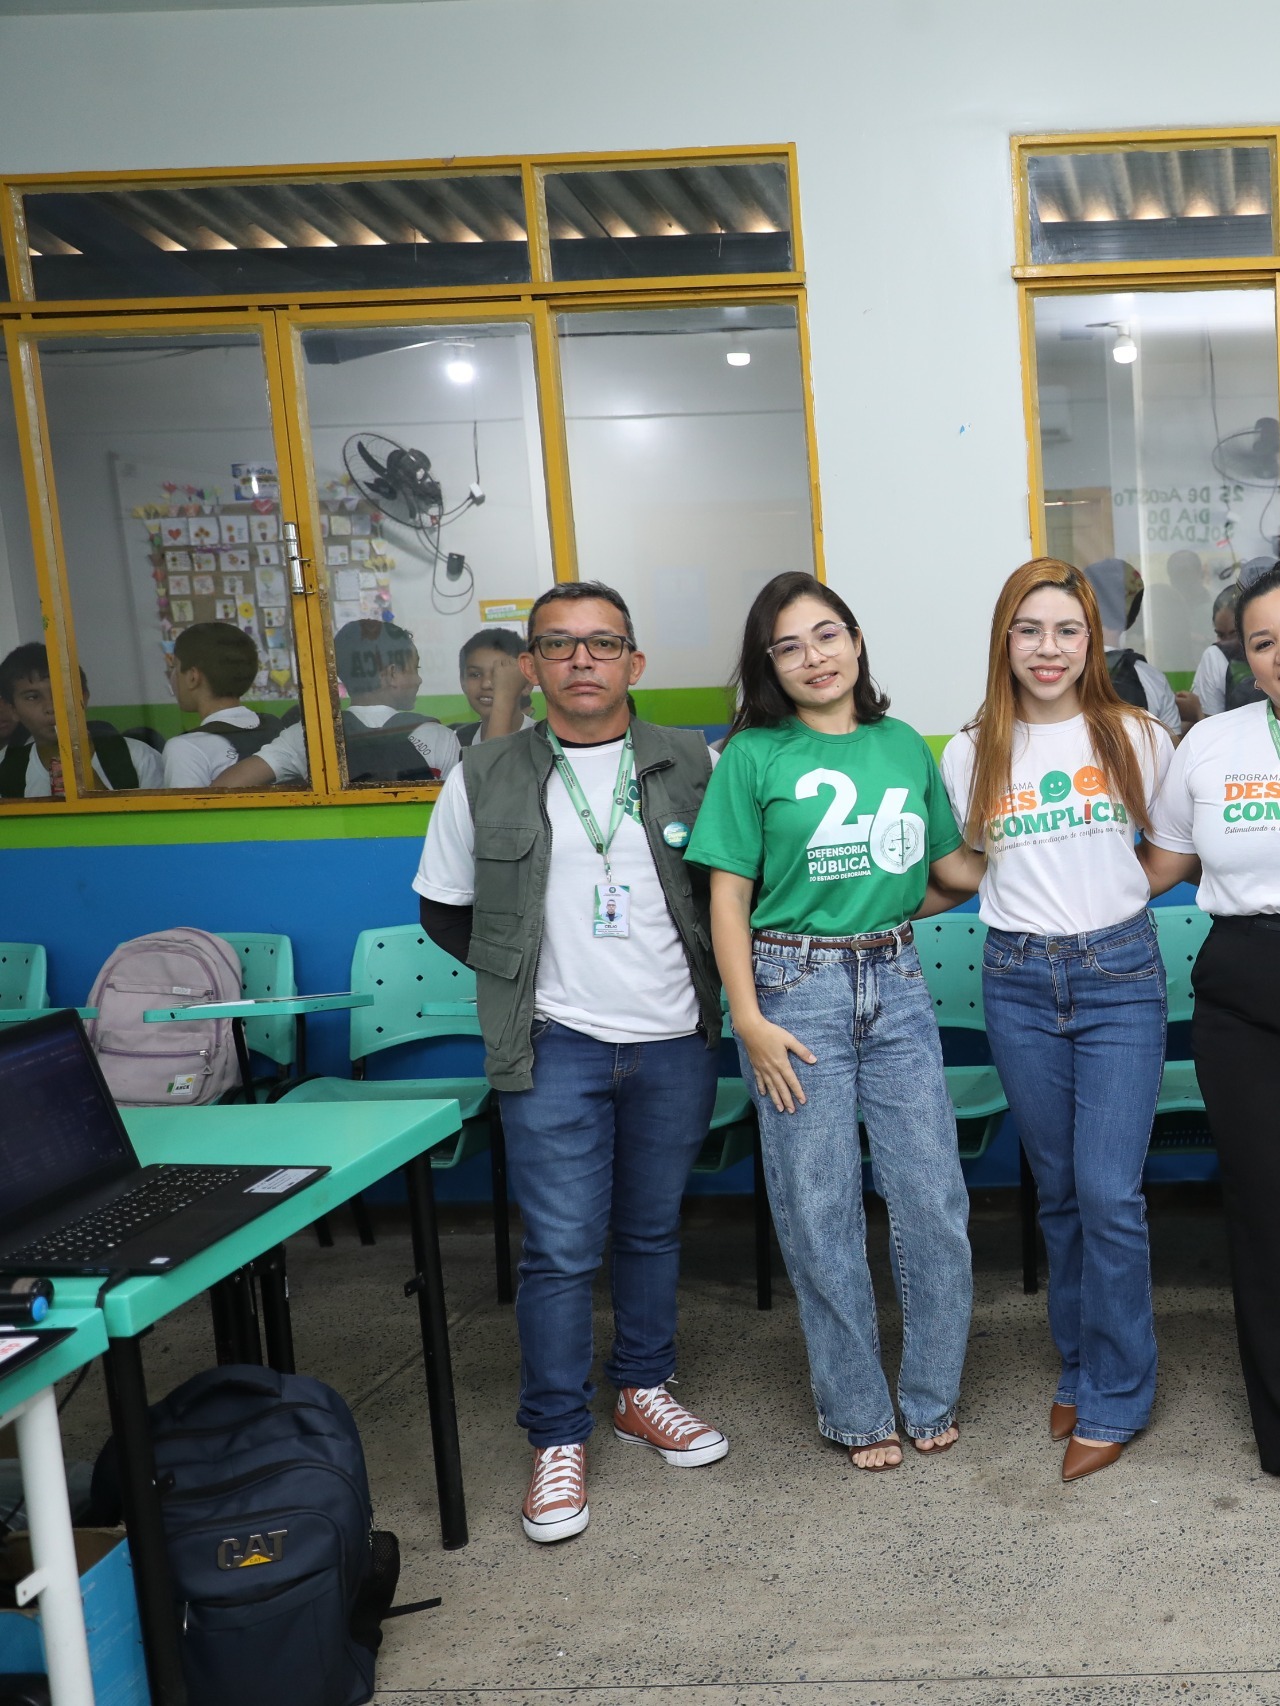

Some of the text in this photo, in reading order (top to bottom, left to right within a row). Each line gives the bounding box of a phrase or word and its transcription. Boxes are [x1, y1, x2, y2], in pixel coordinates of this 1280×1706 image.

[409, 735, 432, 756] RIZADO
[795, 768, 925, 875] 26
[989, 798, 1129, 843] COMPLICA
[807, 844, 868, 860] DEFENSORIA
[808, 855, 871, 875] PÚBLICA
[817, 874, 840, 882] ESTADO
[847, 870, 872, 878] RORAIMA
[217, 1529, 289, 1571] CAT
